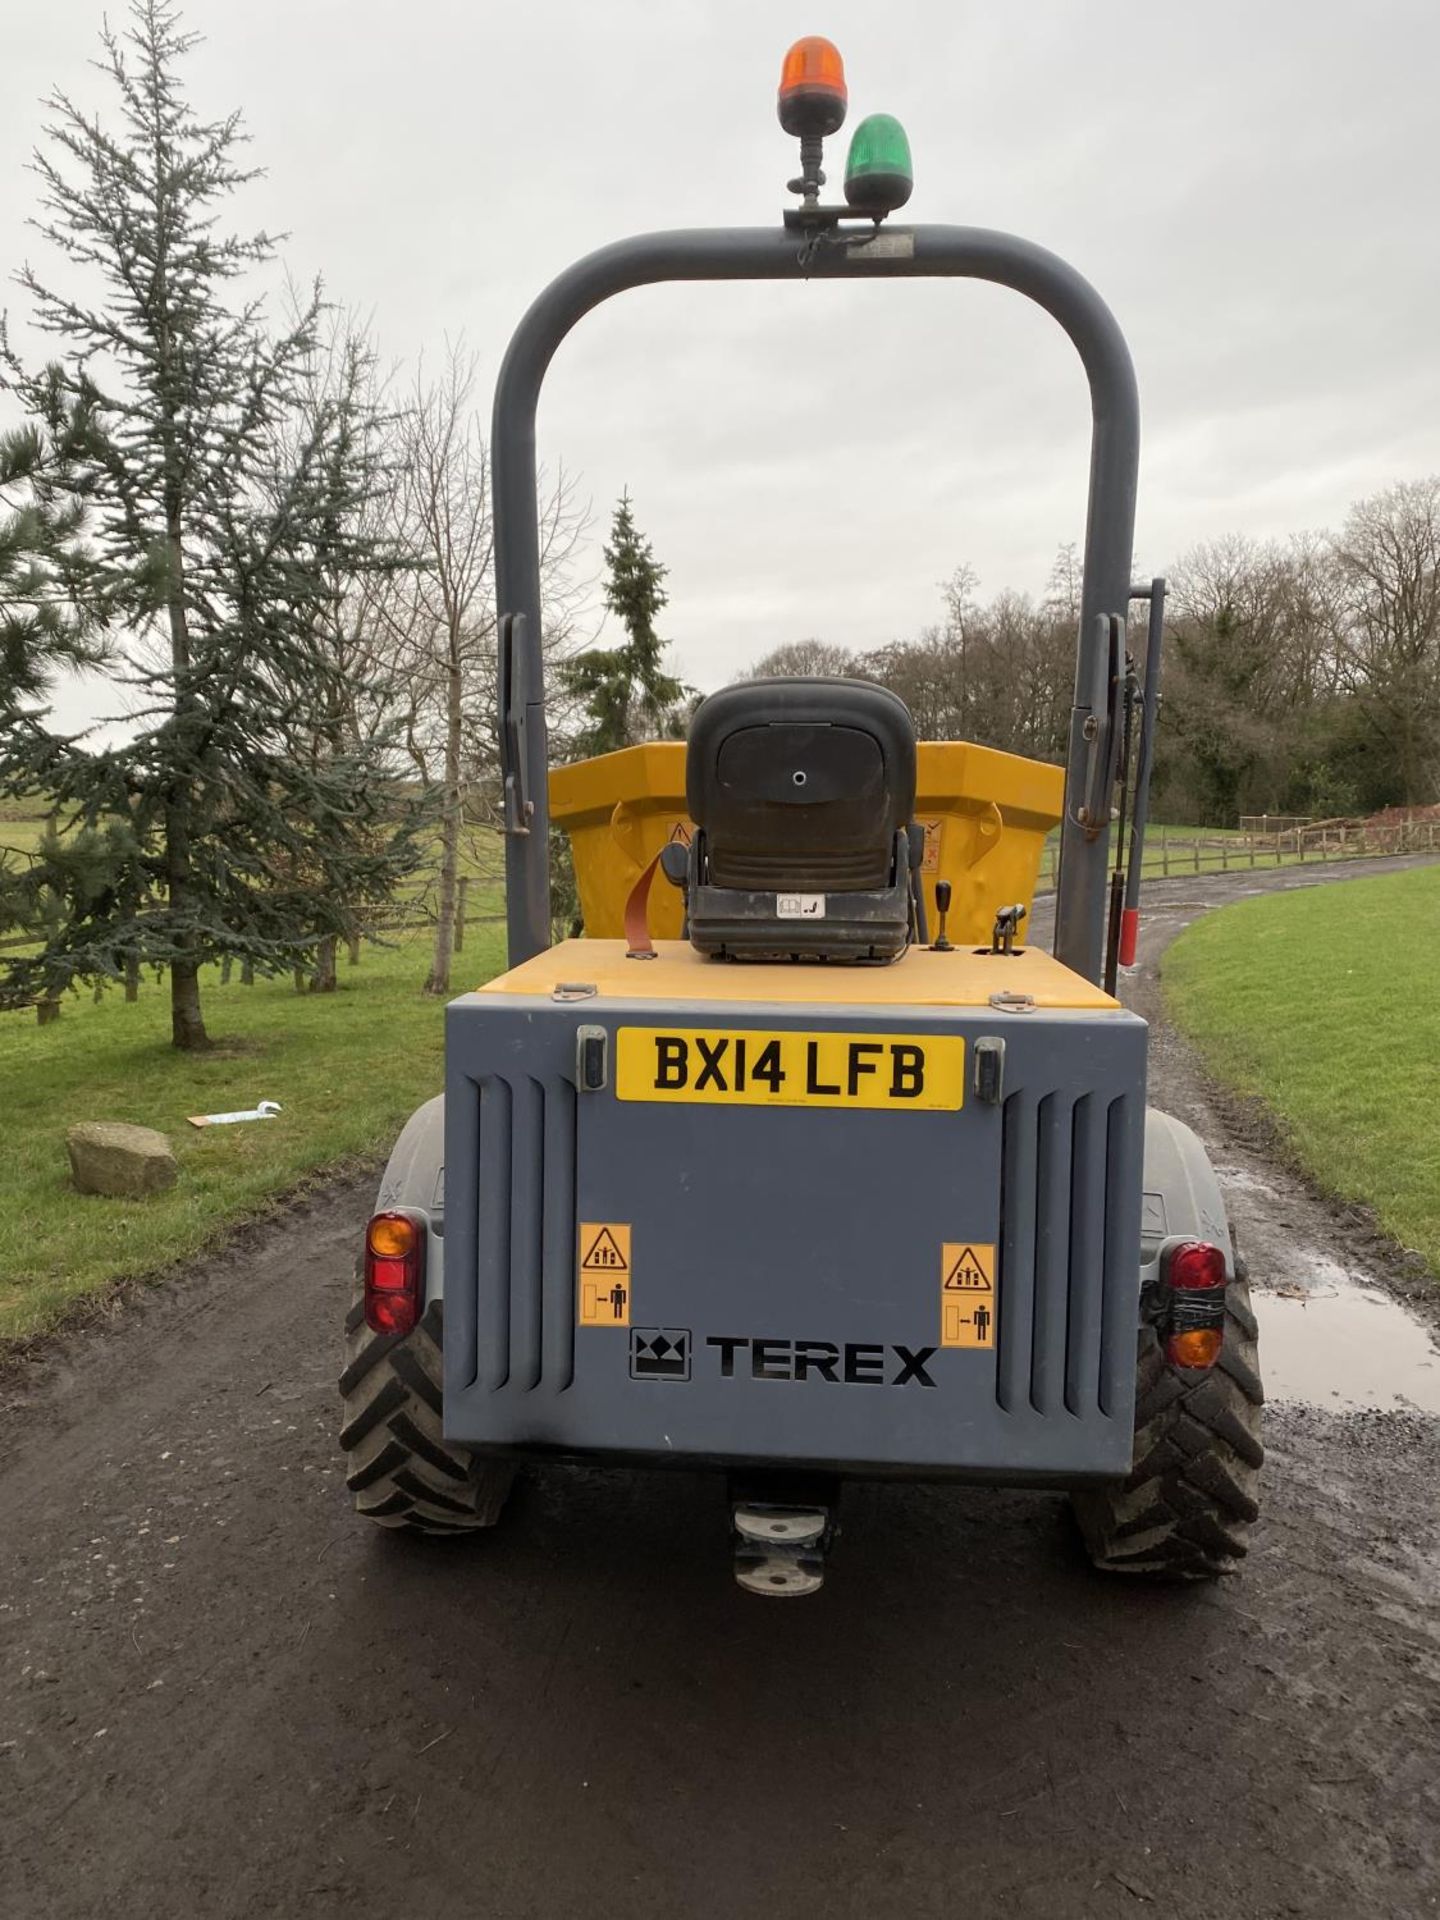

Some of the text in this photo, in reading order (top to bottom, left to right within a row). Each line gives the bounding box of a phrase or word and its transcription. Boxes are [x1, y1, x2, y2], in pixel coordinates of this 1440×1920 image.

[654, 1036, 925, 1098] BX14 LFB
[706, 1336, 939, 1388] TEREX
